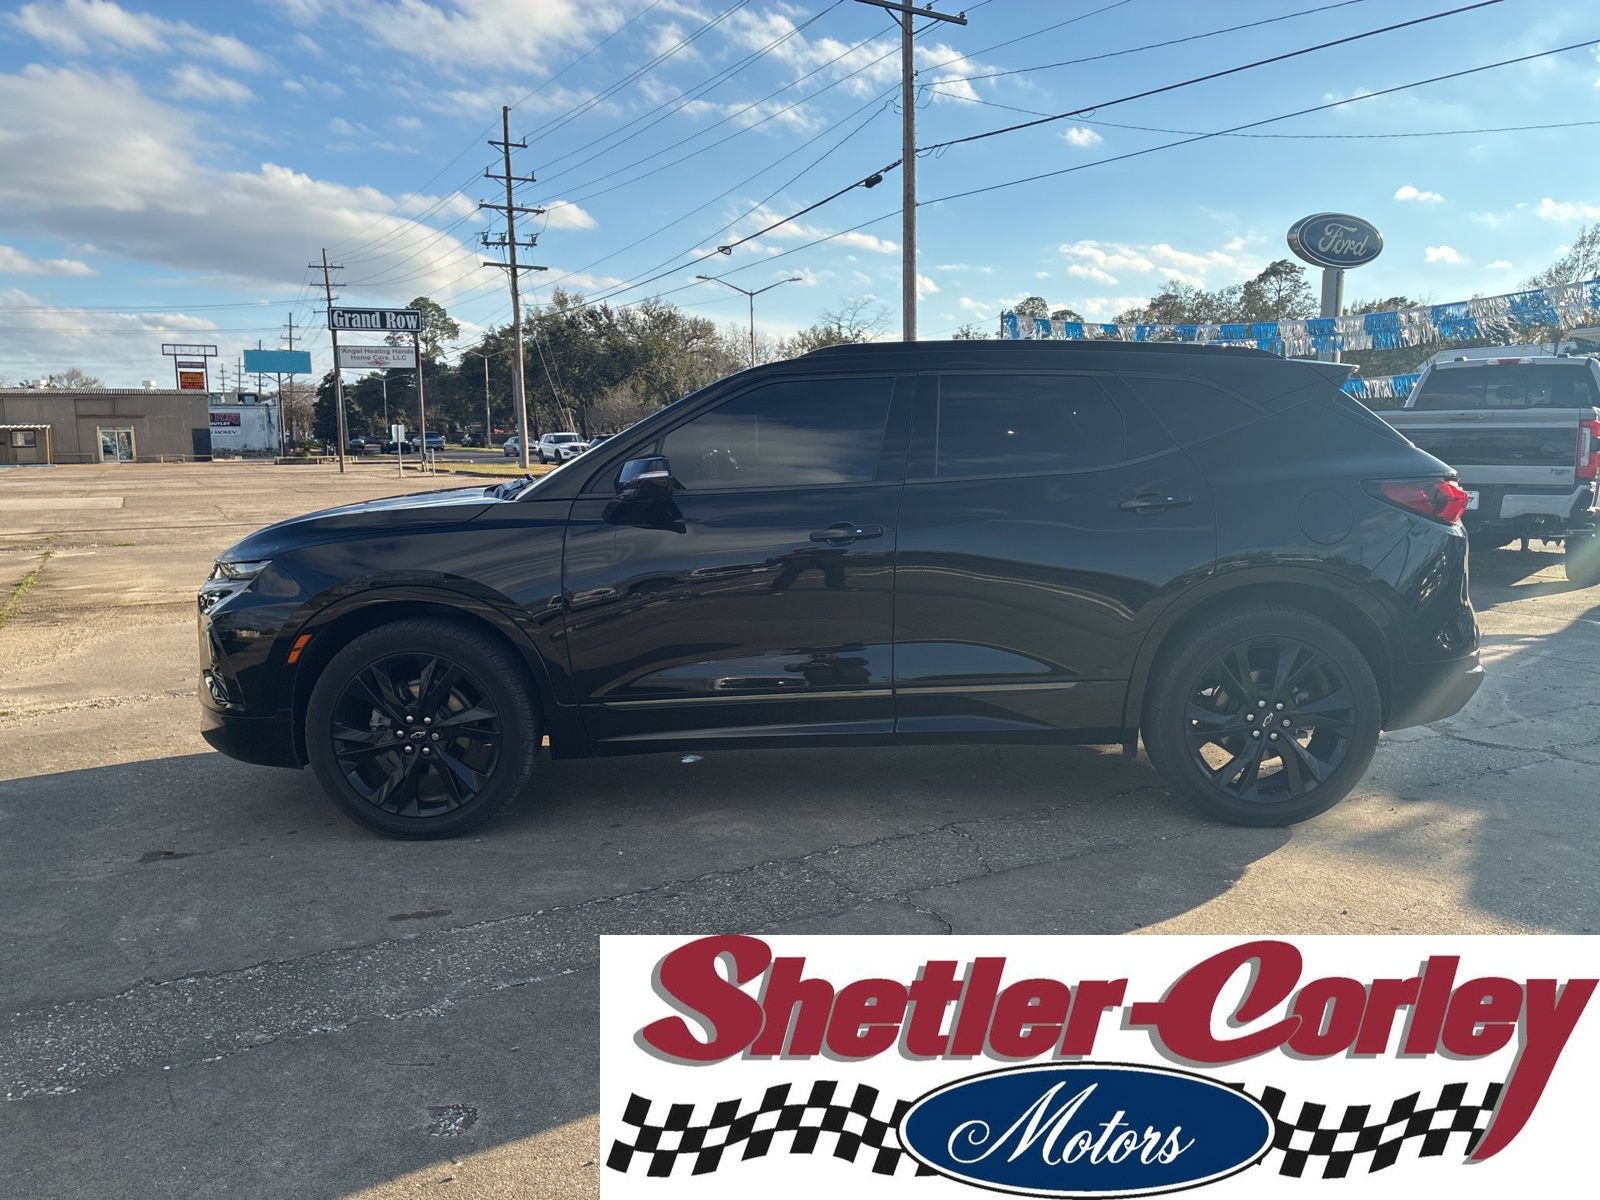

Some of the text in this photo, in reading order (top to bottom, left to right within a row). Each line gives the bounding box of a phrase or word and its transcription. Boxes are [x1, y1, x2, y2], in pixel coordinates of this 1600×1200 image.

[1318, 223, 1369, 256] Ford
[333, 310, 418, 329] Grand Row
